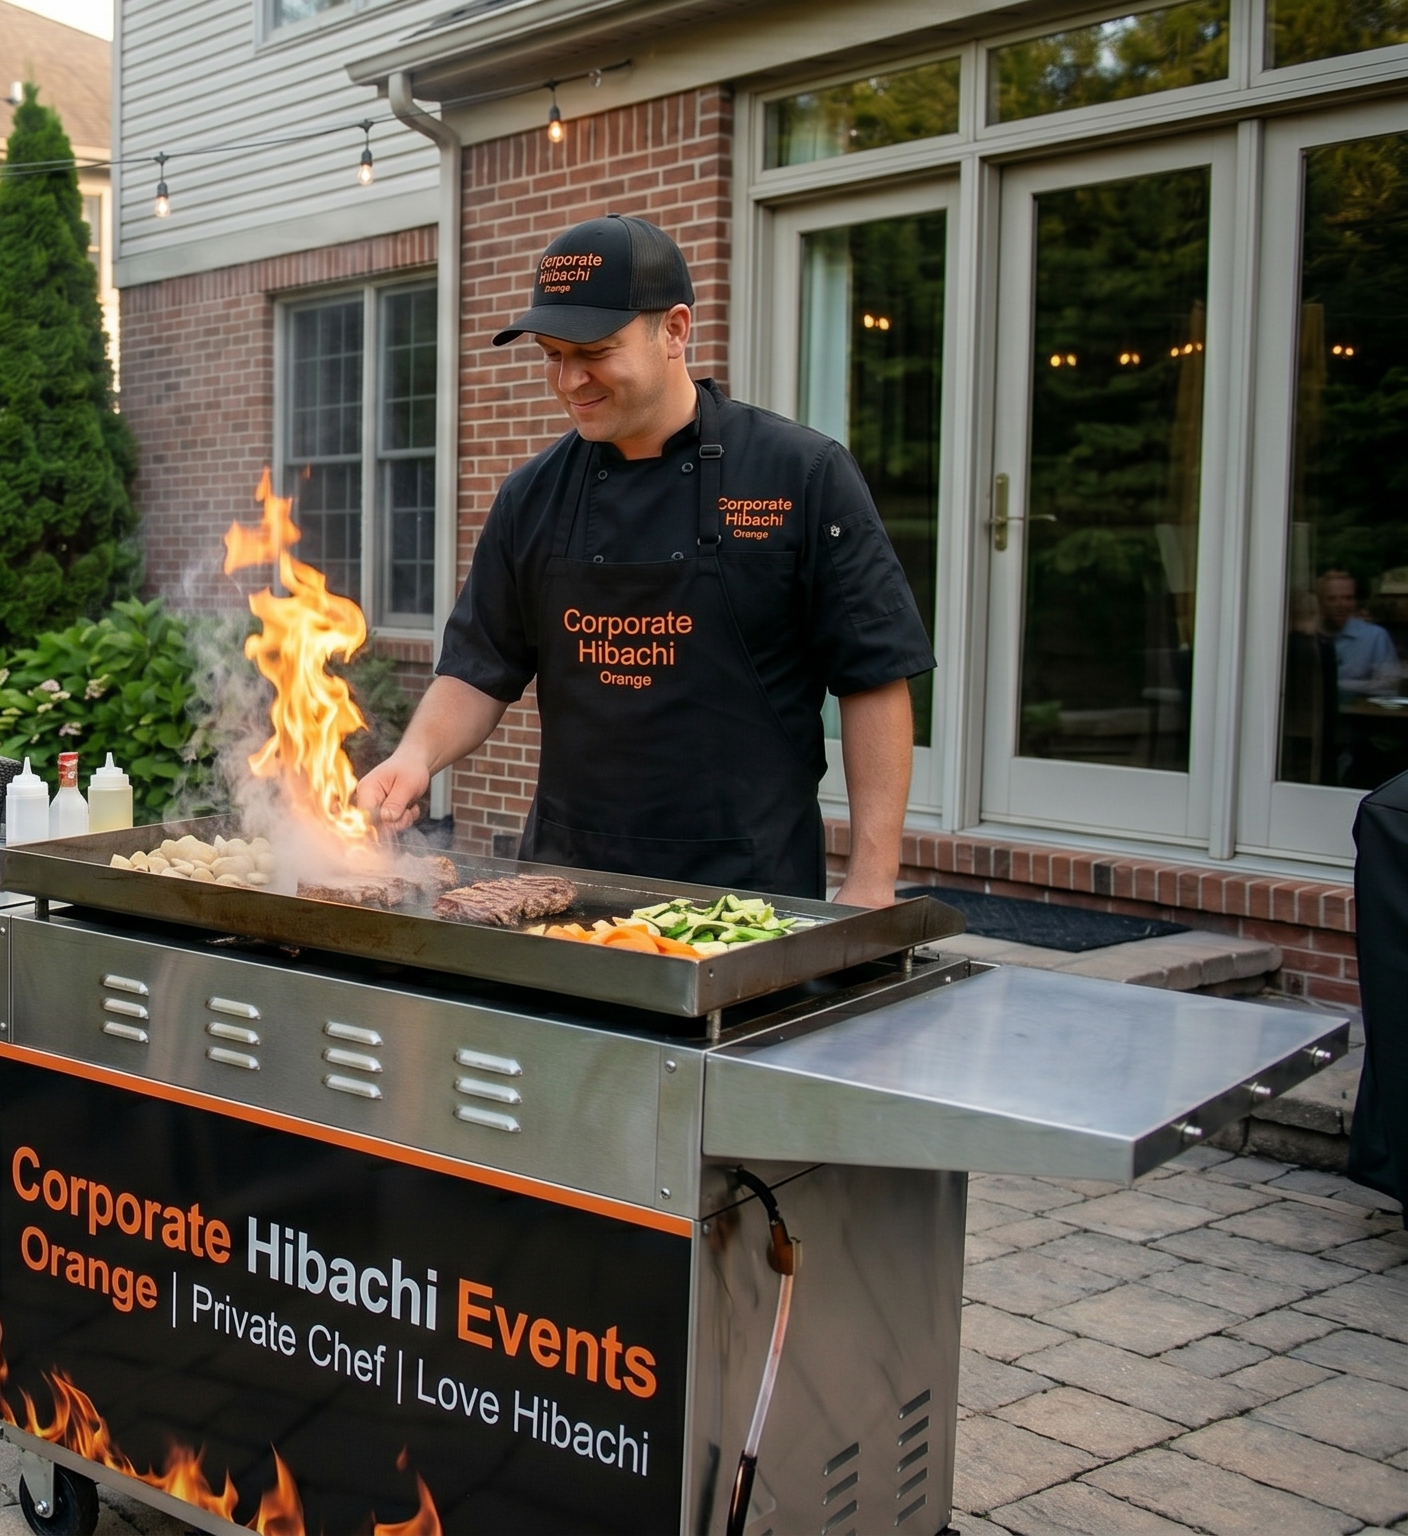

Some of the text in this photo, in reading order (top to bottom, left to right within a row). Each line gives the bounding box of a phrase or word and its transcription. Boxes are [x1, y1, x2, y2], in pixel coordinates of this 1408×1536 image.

[718, 497, 793, 514] Corporate
[725, 511, 784, 527] Hibachi
[563, 608, 693, 640] Corporate
[578, 639, 675, 666] Hibachi
[599, 670, 652, 689] Orange
[12, 1146, 658, 1399] Corporate Hibachi Events
[21, 1225, 159, 1313] Orange
[193, 1283, 296, 1356] Private
[308, 1324, 387, 1387] Chef
[417, 1358, 500, 1425] Love
[513, 1390, 649, 1477] Hibachi
